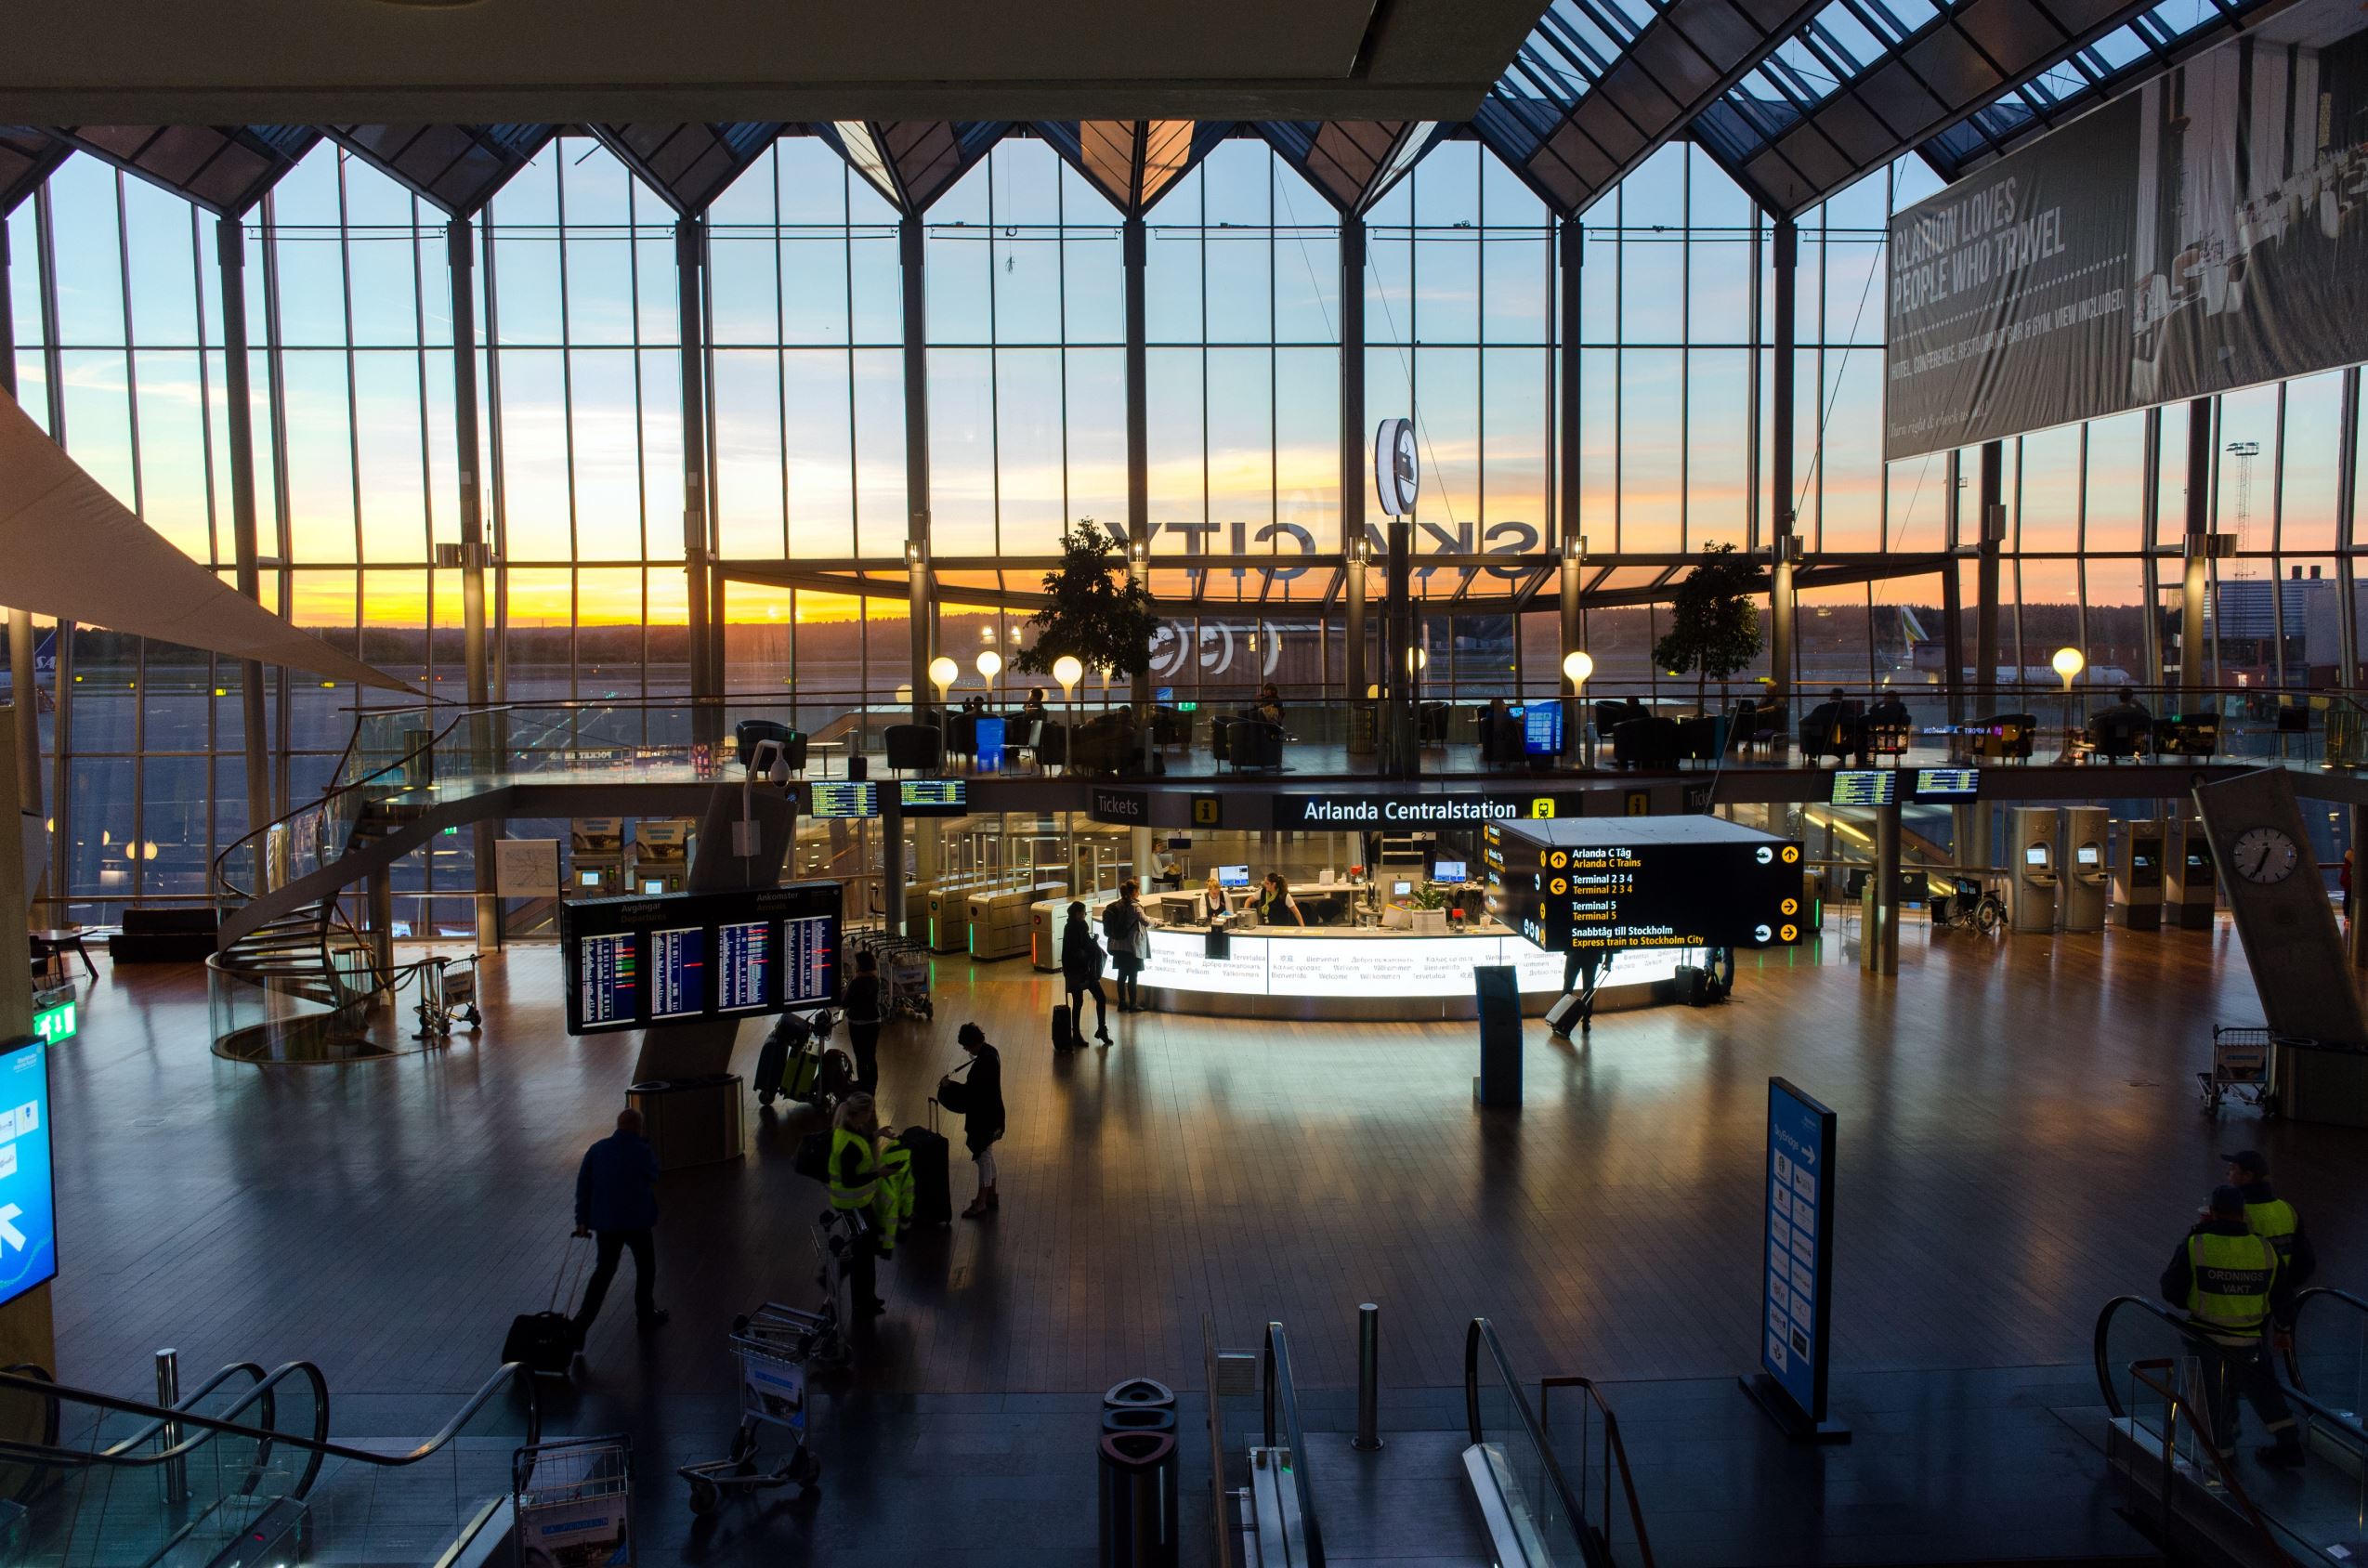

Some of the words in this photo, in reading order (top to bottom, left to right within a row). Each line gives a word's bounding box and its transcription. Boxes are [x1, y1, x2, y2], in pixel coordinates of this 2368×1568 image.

[1894, 205, 1958, 273] CLARION
[1961, 176, 2016, 244] LOVES
[1892, 257, 1948, 318] PEOPLE
[1953, 239, 1990, 295] WHO
[1995, 206, 2065, 277] TRAVEL
[1914, 346, 1956, 373] CONFERENCE,
[2007, 323, 2023, 344] BAR
[2024, 321, 2032, 339] &
[2033, 315, 2052, 335] GYM.
[2055, 304, 2077, 330] VIEW
[2078, 288, 2126, 324] INCLUDED.
[1890, 423, 1906, 438] Turn
[1907, 417, 1927, 438] right
[1927, 417, 1934, 430] &
[1934, 409, 1957, 428] check
[35, 656, 57, 670] SA
[1097, 795, 1139, 817] Tickets
[1303, 801, 1379, 819] Arlanda
[1384, 800, 1516, 819] Centralstation
[1573, 849, 1606, 858] Arlanda
[1608, 849, 1615, 857] C
[1616, 848, 1632, 860] Tåg
[1573, 859, 1607, 869] Arlanda
[1608, 859, 1616, 868] C
[1616, 858, 1642, 868] Trains
[1572, 874, 1610, 884] Terminal
[1611, 874, 1617, 883] 2
[1618, 874, 1626, 883] 3
[1626, 874, 1633, 882] 4
[1572, 884, 1610, 895] Terminal
[1611, 884, 1617, 894] 2
[1618, 884, 1626, 894] 3
[1626, 884, 1633, 894] 4
[756, 892, 799, 902] Ankomster
[621, 901, 661, 914] Avgångar
[1572, 901, 1610, 910] Terminal
[1610, 901, 1617, 910] 5
[1572, 911, 1610, 921] Terminal
[1610, 911, 1617, 921] 5
[1572, 927, 1613, 939] Snabbtåg
[1615, 926, 1627, 935] till
[1629, 924, 1673, 935] Stockholm
[1572, 937, 1605, 948] Express
[1606, 936, 1627, 946] train
[1629, 936, 1638, 946] to
[1641, 934, 1686, 946] Stockholm
[1687, 934, 1705, 947] City
[2207, 1269, 2265, 1282] ORDNINGS
[2222, 1284, 2252, 1294] VAKT
